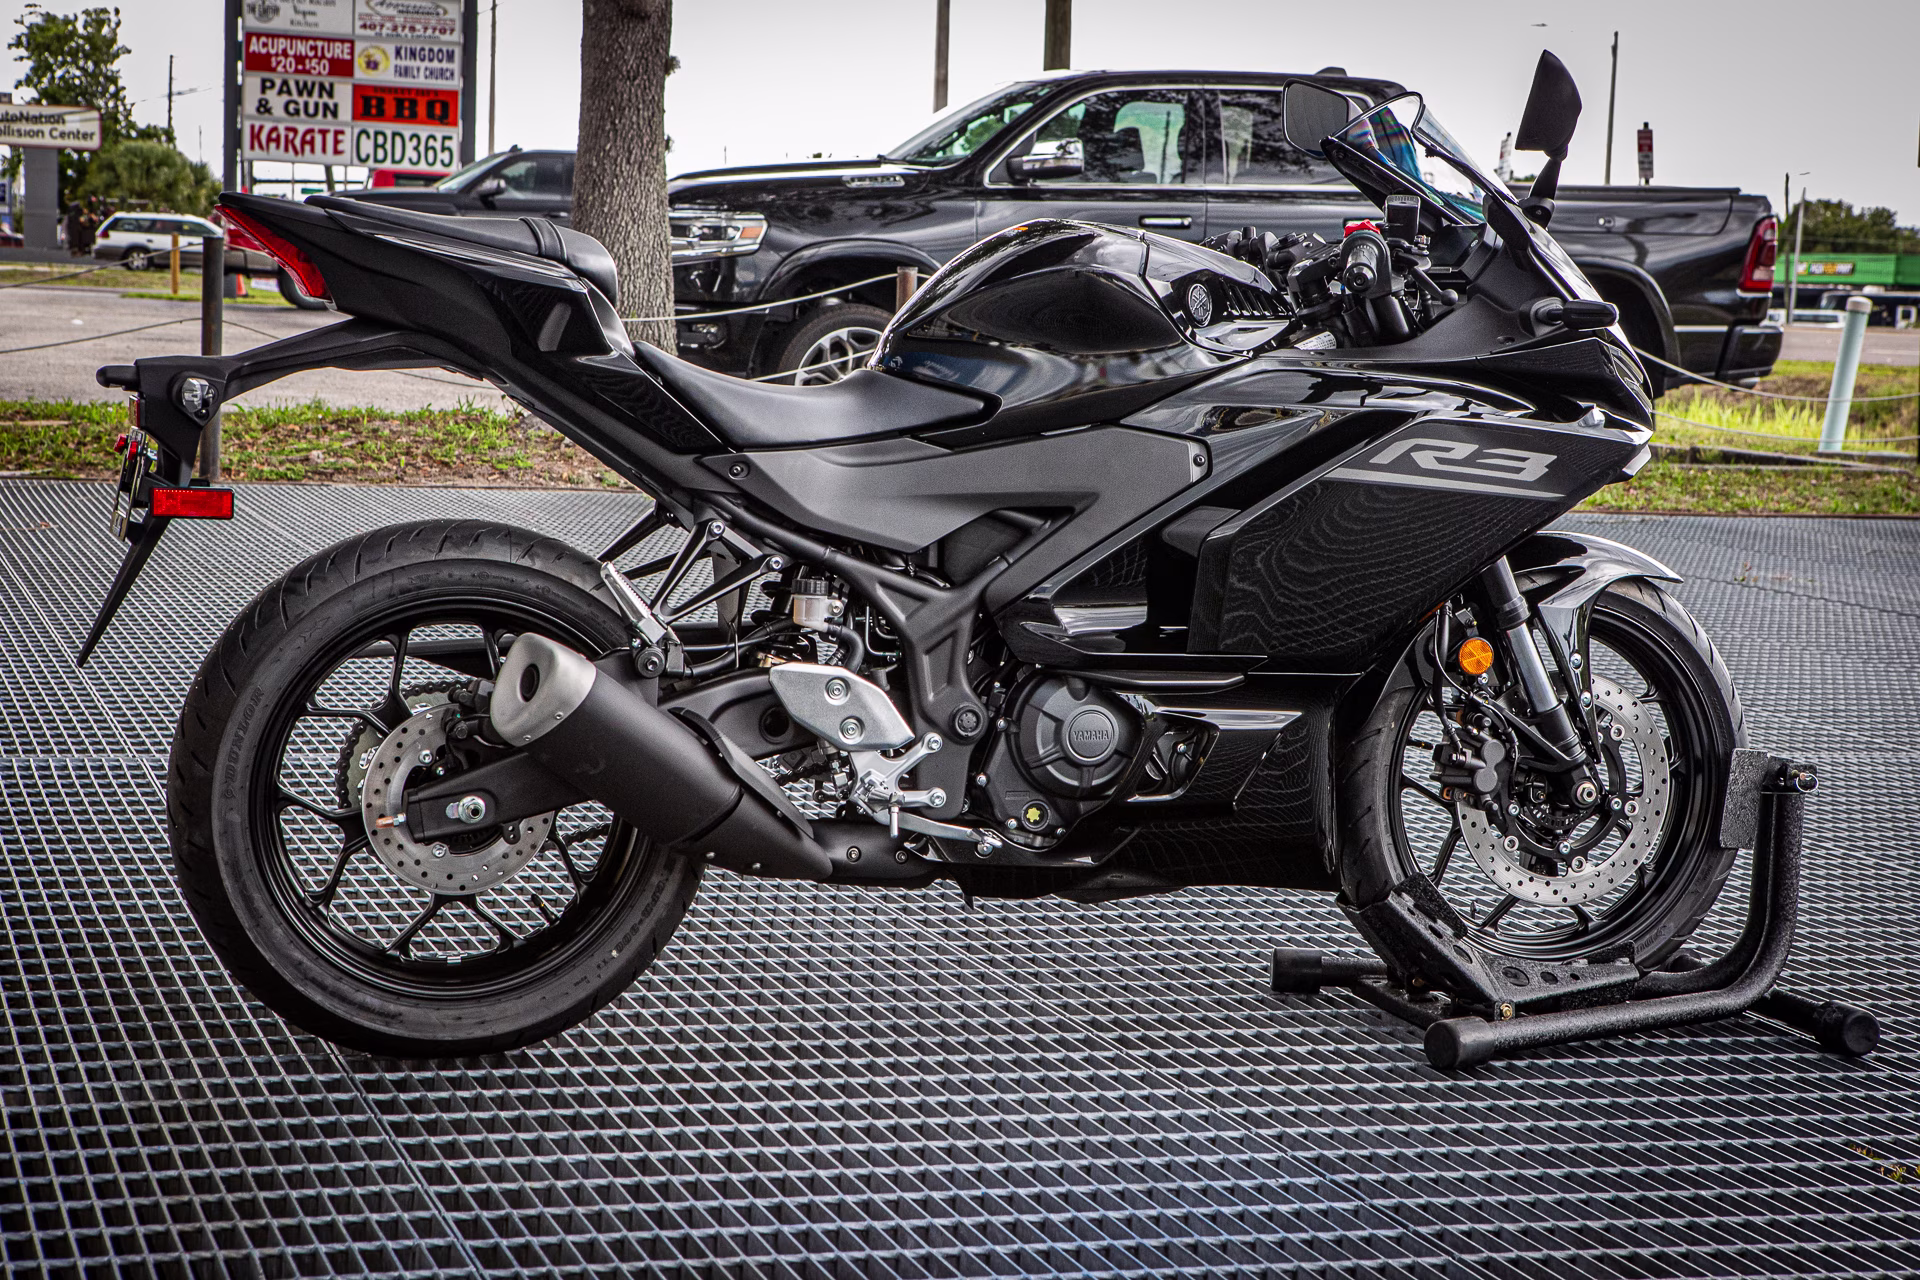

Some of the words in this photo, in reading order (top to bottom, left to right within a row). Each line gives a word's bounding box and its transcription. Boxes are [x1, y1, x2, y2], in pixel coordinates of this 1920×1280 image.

[249, 35, 352, 60] ACUPUNCTURE
[394, 45, 455, 64] KINGDOM
[393, 64, 420, 79] FAMILY
[423, 66, 455, 81] CHURCH
[260, 78, 334, 99] PAWN
[255, 97, 273, 116] &
[283, 99, 339, 119] GUN
[360, 95, 450, 126] BBQ
[48, 127, 95, 141] Center
[249, 123, 346, 157] KARATE
[355, 128, 454, 168] CBD365
[1369, 437, 1558, 482] R3
[1073, 729, 1110, 742] YAMAHA
